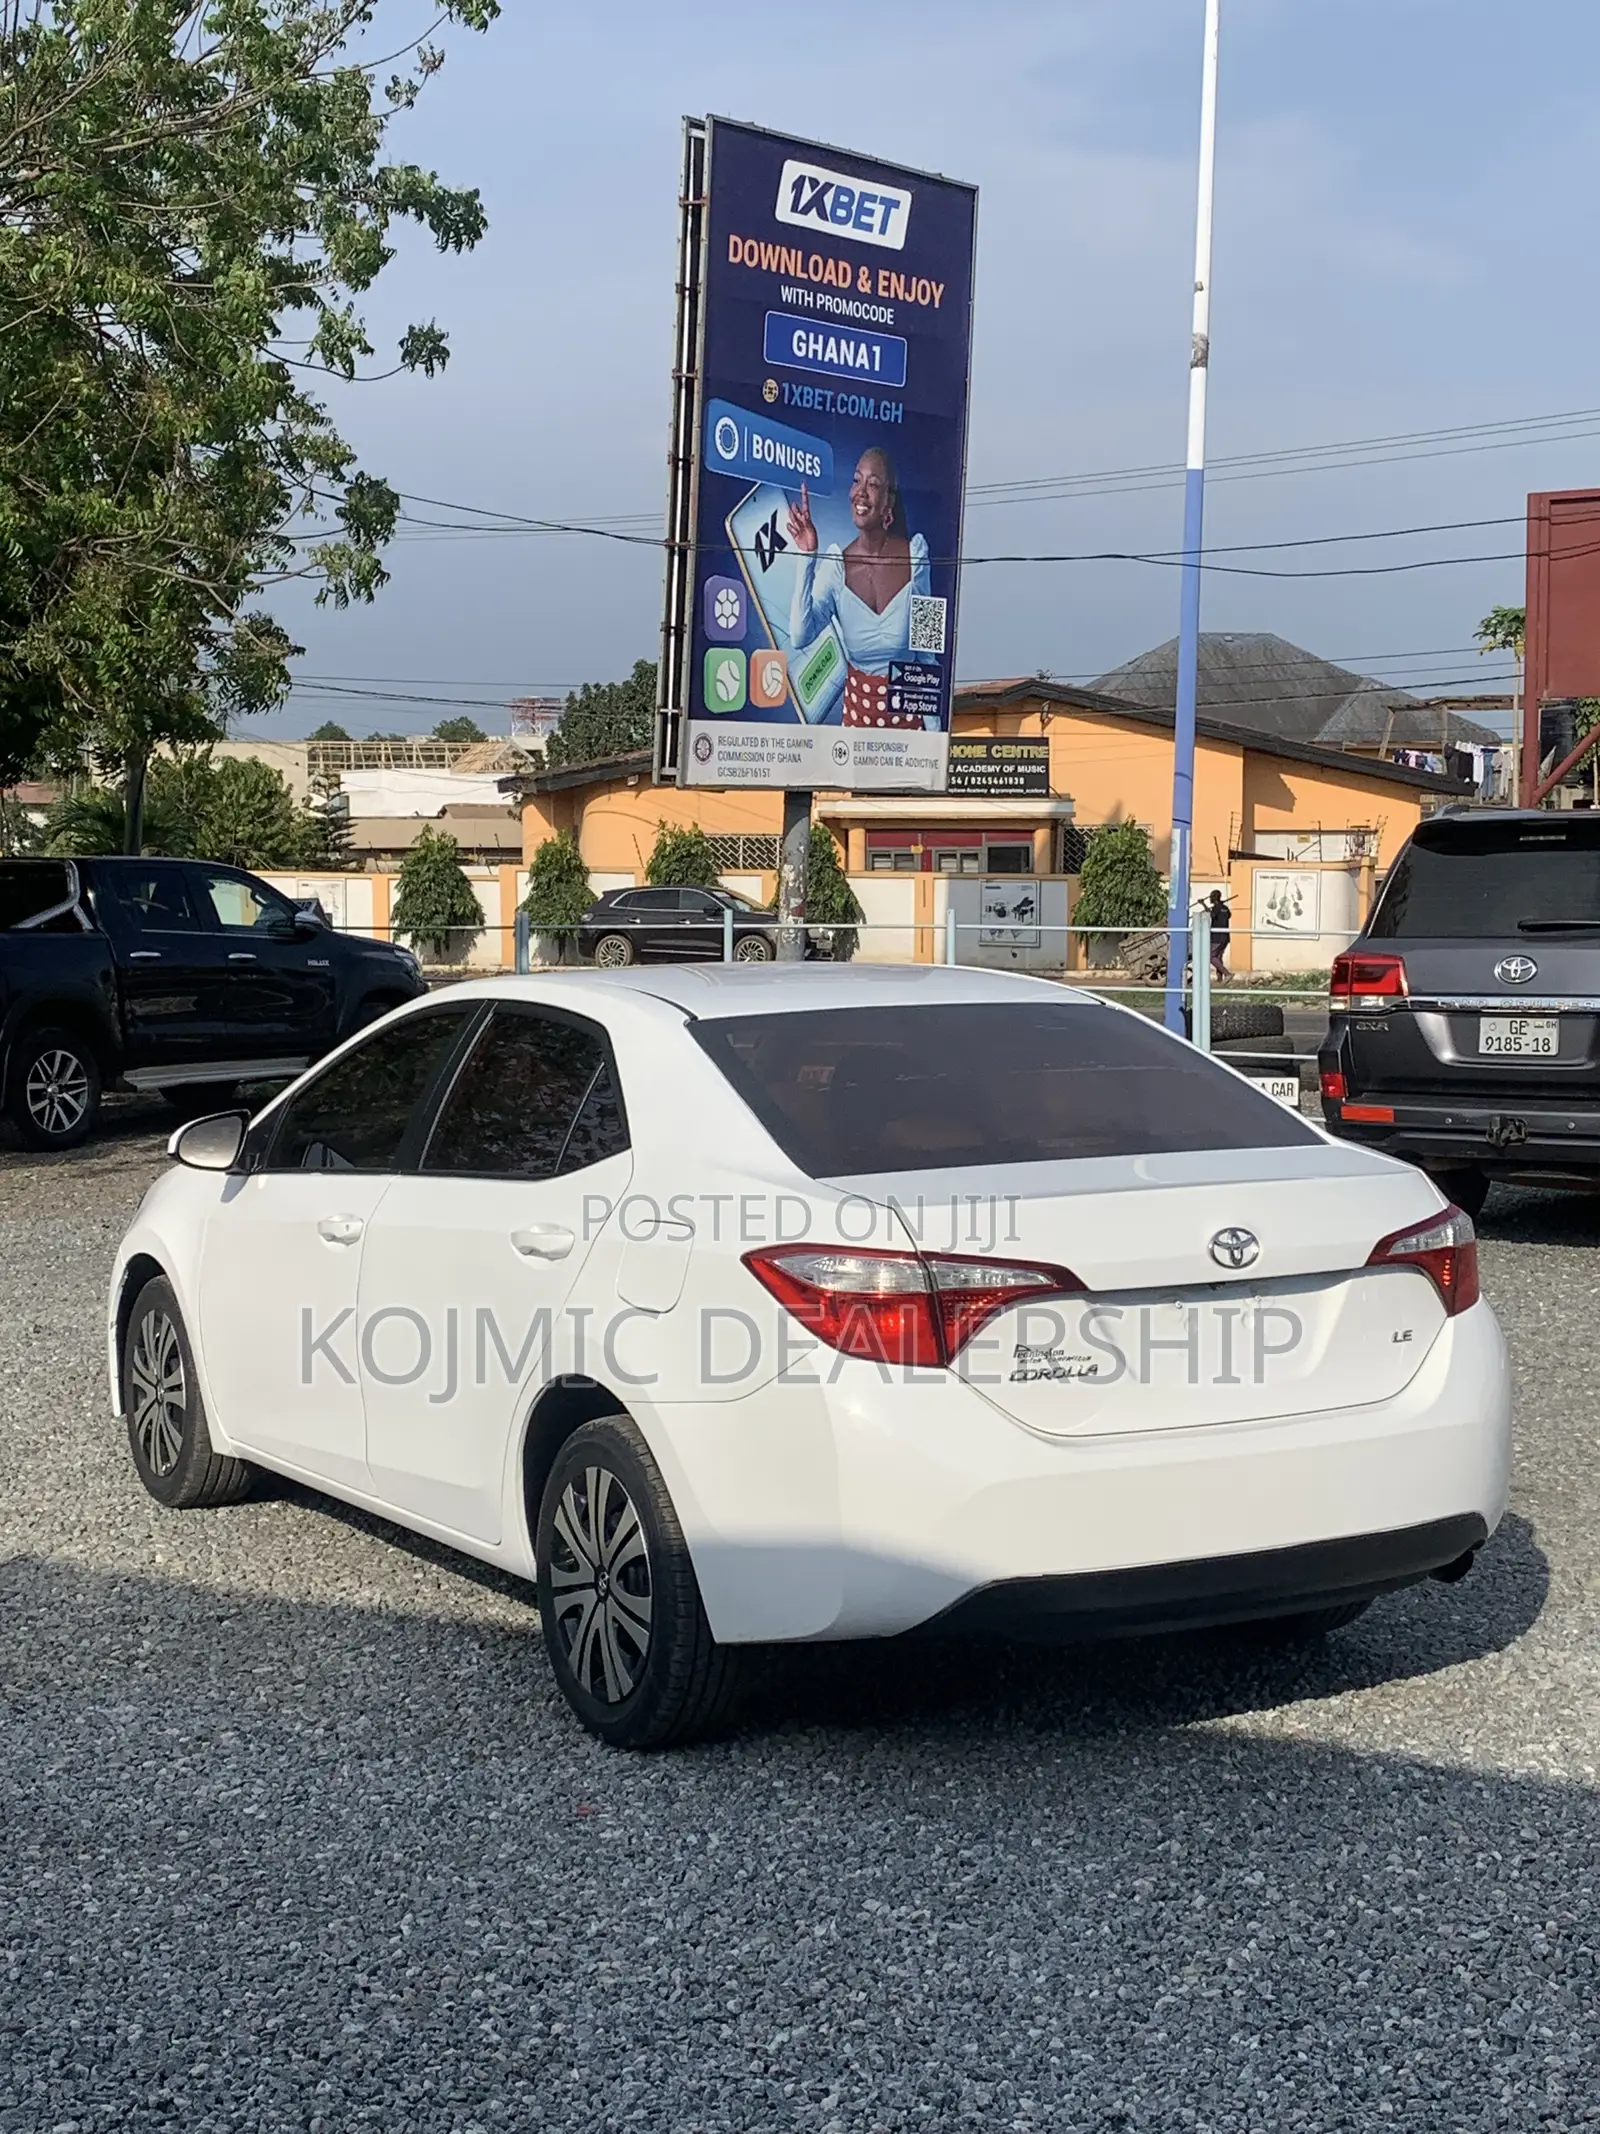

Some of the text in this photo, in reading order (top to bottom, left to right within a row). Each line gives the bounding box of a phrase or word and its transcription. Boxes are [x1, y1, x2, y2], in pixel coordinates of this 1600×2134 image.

[790, 174, 901, 236] 1XBET
[729, 234, 945, 309] DOWNLOAD & ENJOY
[780, 284, 895, 325] WITH PROMOCODE
[792, 329, 881, 372] GHANA1
[782, 382, 903, 424] 1XBET.COM.GH
[752, 433, 821, 478] BONUSES
[904, 671, 940, 687] Google Play
[903, 699, 938, 713] App Store
[717, 735, 759, 748] REGULATED
[760, 737, 770, 748] BY
[771, 738, 785, 748] THE
[853, 741, 866, 752] BET
[766, 752, 776, 762] OF
[777, 753, 802, 763] GHANA
[834, 747, 847, 759] 18+
[991, 745, 1049, 759] CENTRE
[880, 756, 894, 767] CAN
[956, 764, 1002, 773] ACADEMY
[1003, 764, 1016, 773] OF
[1018, 765, 1047, 774] MUSIC
[1509, 1020, 1528, 1036] GE
[1485, 1036, 1551, 1053] 9185-18
[1271, 1082, 1294, 1097] CAR
[1391, 1329, 1413, 1343] LE
[1008, 1363, 1099, 1382] COROLLA
